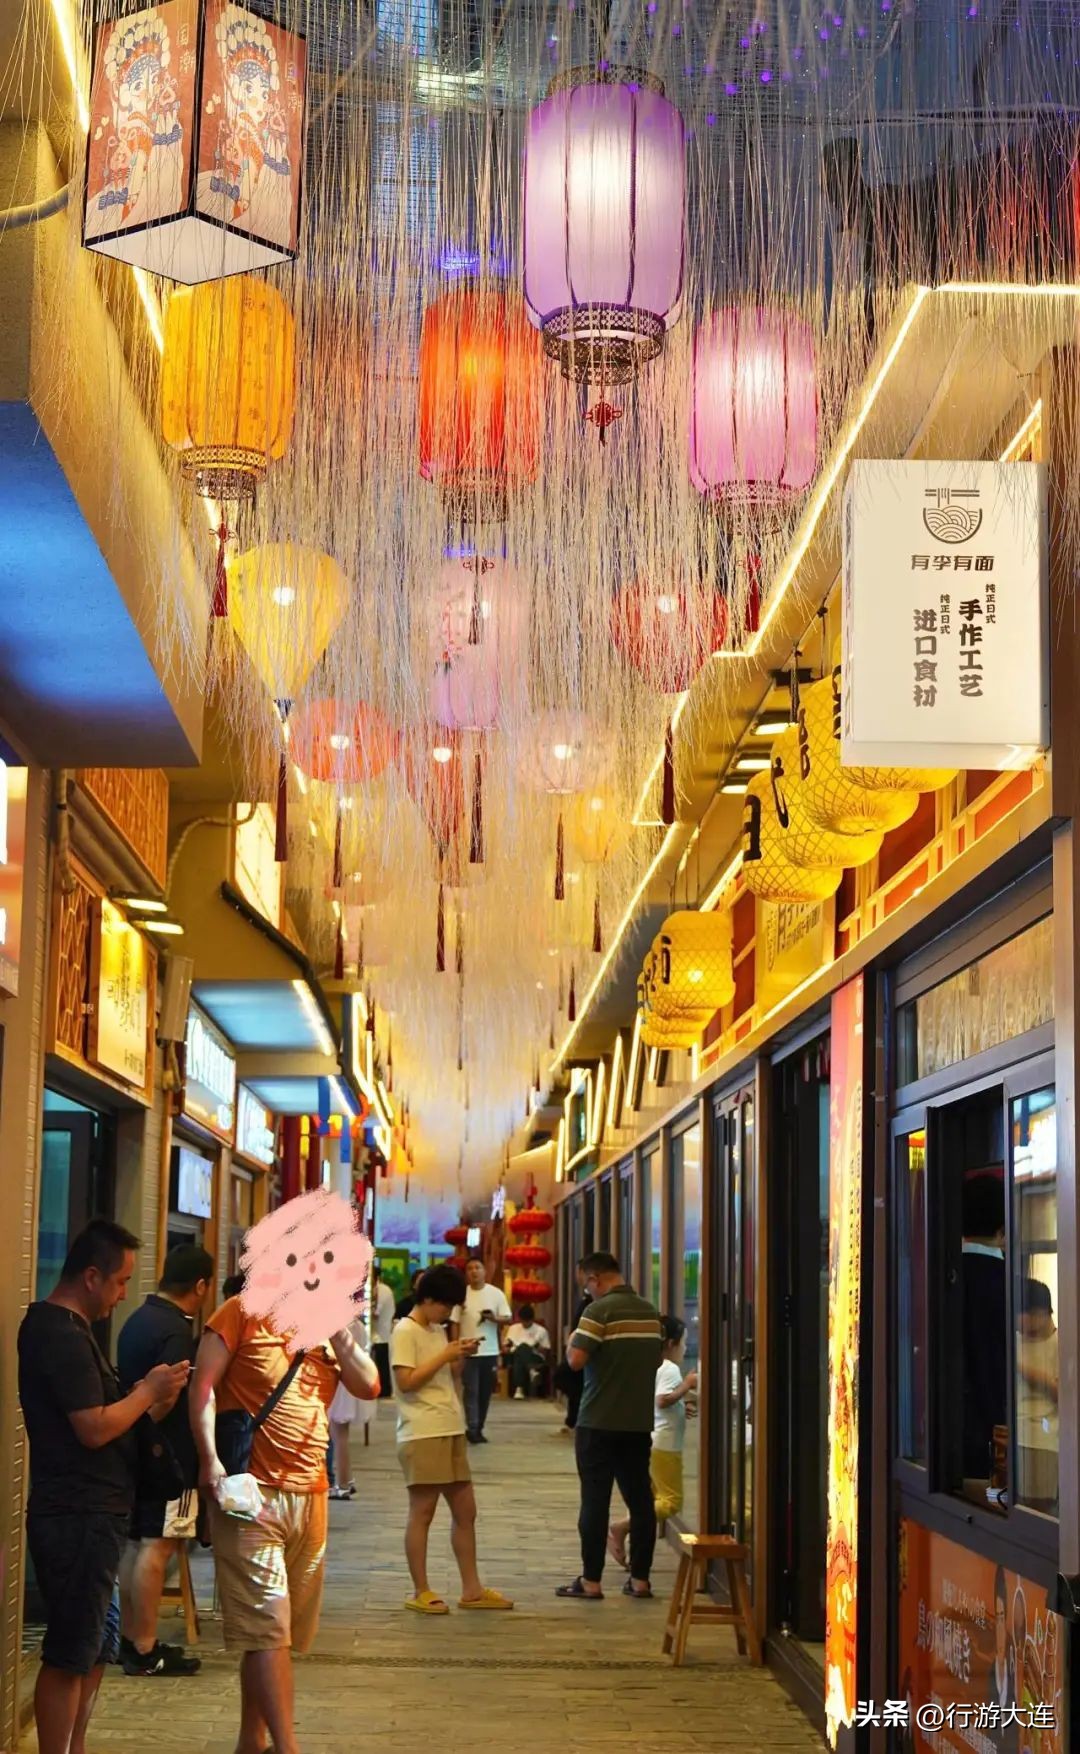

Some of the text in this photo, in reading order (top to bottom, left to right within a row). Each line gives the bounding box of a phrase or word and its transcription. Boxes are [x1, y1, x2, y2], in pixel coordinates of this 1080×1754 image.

[911, 554, 995, 571] 有李有面
[940, 594, 951, 635] 纯正日式
[985, 583, 996, 624] 纯正日式
[913, 608, 938, 707] 进口食材
[958, 598, 983, 697] 手作工艺
